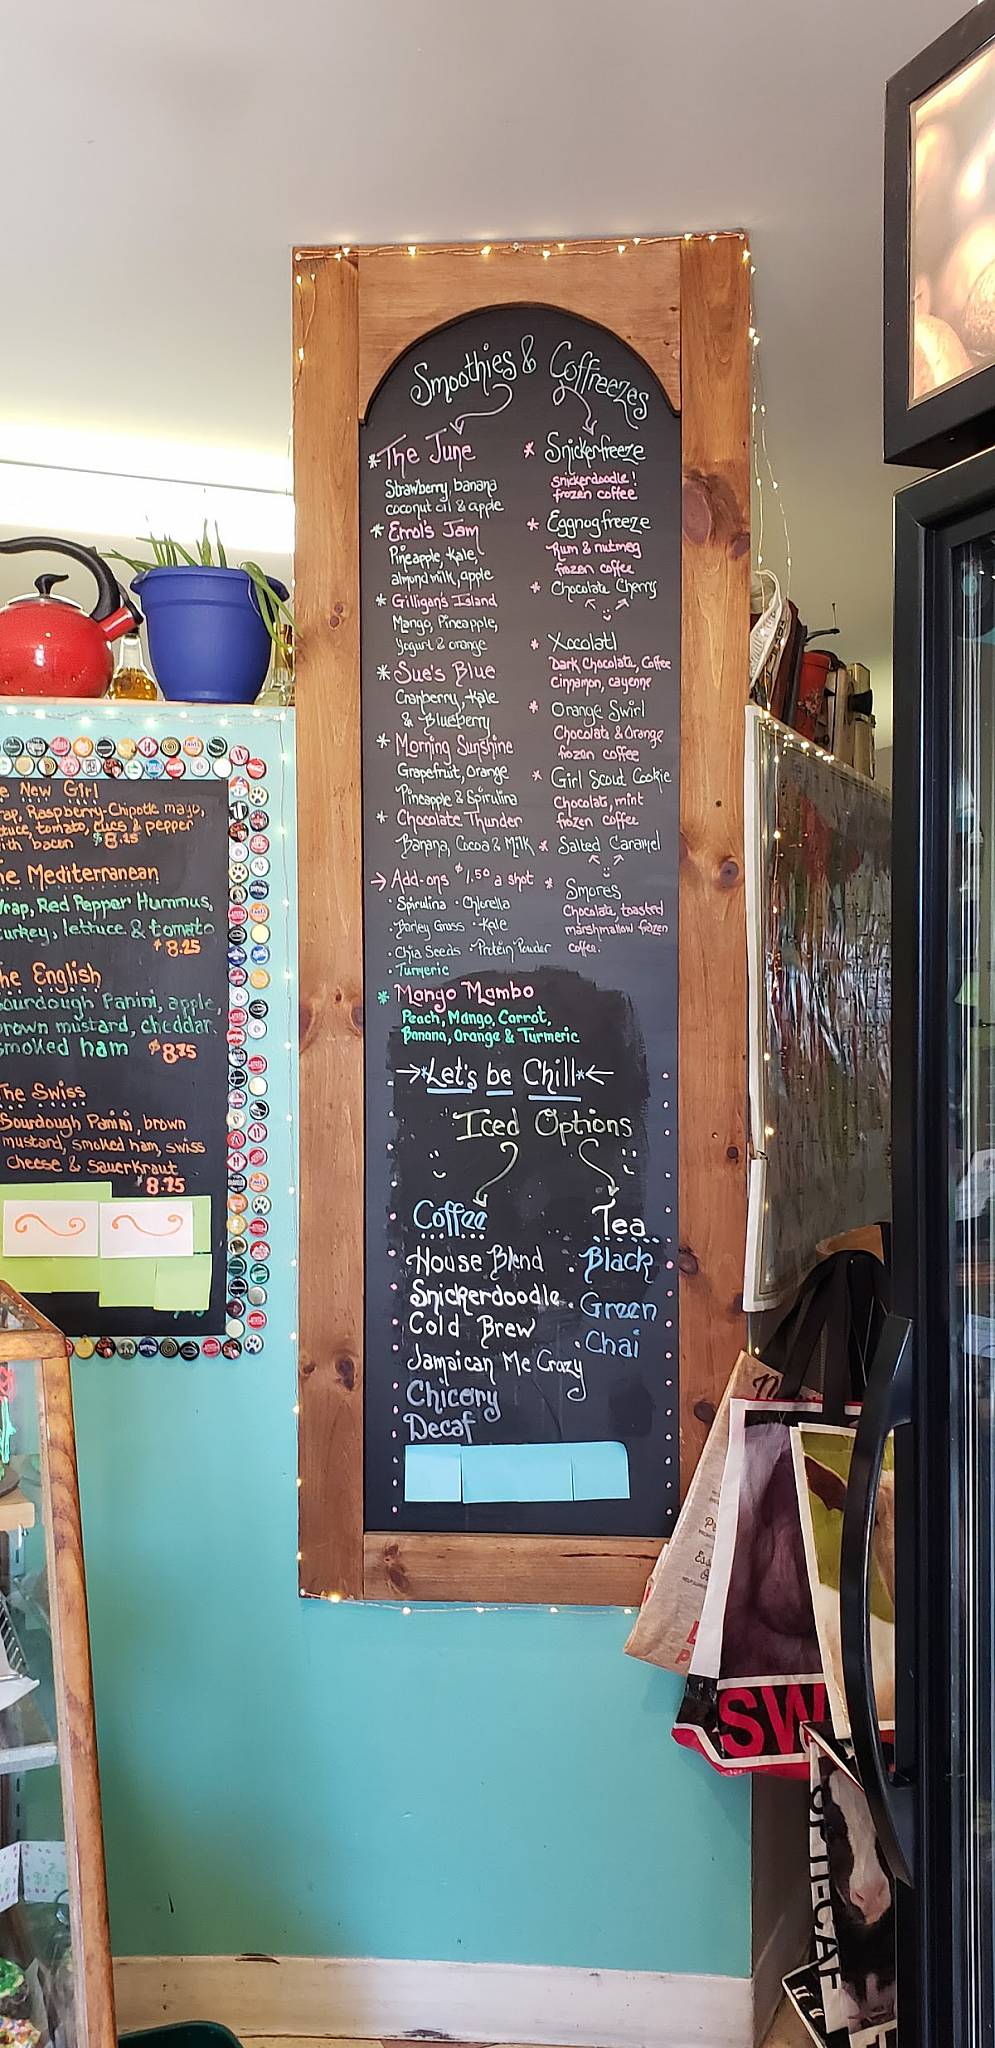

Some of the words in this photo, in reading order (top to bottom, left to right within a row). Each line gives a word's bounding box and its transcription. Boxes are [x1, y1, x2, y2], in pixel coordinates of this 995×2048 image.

[410, 344, 517, 406] Smoothies
[522, 334, 536, 373] &
[550, 341, 648, 429] Coffreezes
[379, 434, 420, 478] The
[425, 429, 475, 472] June
[545, 432, 646, 475] Snickerfreeze
[454, 478, 497, 500] banana
[553, 488, 592, 502] frozen
[597, 488, 637, 500] coffee
[385, 501, 432, 519] coconut
[435, 500, 451, 513] oil
[456, 500, 466, 512] &
[469, 501, 504, 519] apple
[442, 519, 484, 555] Jam
[389, 545, 444, 572] Pineapple,
[546, 542, 578, 561] Rum
[582, 541, 592, 554] &
[594, 542, 641, 558] nutmeg
[555, 562, 595, 576] frozen
[600, 561, 634, 577] coffee
[551, 581, 610, 603] Chocolate
[616, 578, 658, 599] Cherry
[391, 593, 448, 614] Gilligan's
[452, 593, 497, 607] Island
[392, 616, 433, 634] Mango,
[438, 615, 497, 632] Pineapple,
[396, 637, 434, 654] Yogurt
[436, 638, 445, 649] &
[548, 632, 617, 651] Xocolatl
[394, 662, 445, 684] Sue's
[452, 661, 496, 687] Blue
[549, 657, 580, 672] Dark
[582, 657, 639, 673] Chocolate,
[641, 657, 671, 670] Coffee
[396, 689, 465, 714] Cranberry,
[551, 701, 602, 727] Orange
[609, 700, 645, 722] Swirl
[401, 714, 413, 727] &
[418, 714, 491, 740] Blueberry
[614, 725, 623, 739] &
[624, 725, 665, 749] Orange
[395, 734, 452, 765] Morning
[456, 735, 513, 763] Sunshine
[558, 749, 595, 761] frozen
[602, 748, 640, 763] coffee
[397, 763, 465, 784] Grapefruit,
[551, 766, 583, 789] Girl
[588, 769, 626, 789] Scout
[632, 767, 672, 793] Cookie
[20, 781, 51, 797] New
[63, 779, 98, 798] Girl
[395, 785, 453, 808] Pineapple
[456, 791, 465, 804] &
[466, 786, 517, 813] Spirulina
[614, 792, 643, 806] mint
[145, 819, 194, 836] pepper
[397, 810, 463, 837] Chocolate
[463, 811, 523, 833] Thunder
[557, 812, 593, 830] frozen
[602, 811, 639, 830] coffee
[32, 837, 74, 851] bacon
[395, 833, 451, 860] Banana,
[456, 839, 490, 853] Cocoa
[491, 838, 500, 851] &
[504, 835, 535, 858] Milk
[558, 835, 600, 856] Salted
[609, 830, 661, 853] Caramel
[27, 863, 159, 891] Mediterranean
[390, 868, 449, 895] Add-ons
[494, 874, 503, 887] a
[508, 871, 534, 891] shot
[566, 878, 622, 901] Smores
[37, 893, 69, 915] Red
[73, 892, 132, 921] Pepper
[136, 891, 213, 913] Hummus,
[397, 896, 446, 918] Spirulina
[462, 896, 510, 918] Chlorella
[620, 901, 664, 917] toasted
[62, 919, 127, 938] lettuce
[130, 919, 145, 941] &
[149, 919, 215, 939] tomato
[565, 922, 634, 942] marshmallow
[638, 921, 668, 935] frozen
[395, 946, 422, 963] Chia
[425, 945, 461, 957] Seeds
[472, 940, 515, 963] Protein
[515, 938, 552, 955] Powder
[32, 960, 102, 994] English
[395, 963, 449, 979] Turmeric
[394, 984, 457, 1013] Mango
[461, 981, 535, 1006] Mambo
[55, 1014, 137, 1038] mustard,
[402, 1009, 446, 1027] Peach,
[448, 1011, 495, 1029] Mango,
[498, 1005, 551, 1026] Carrot,
[79, 1037, 129, 1057] ham
[401, 1027, 452, 1045] Banana,
[454, 1029, 501, 1047] Orange
[505, 1030, 515, 1043] &
[517, 1027, 580, 1043] Turmeric
[427, 1056, 478, 1089] Let's
[487, 1061, 511, 1086] be
[523, 1057, 576, 1094] Chill
[31, 1080, 87, 1100] Swiss
[144, 1114, 188, 1131] brown
[453, 1108, 520, 1141] Iced
[535, 1108, 632, 1146] Options
[2, 1135, 67, 1155] mustard,
[72, 1138, 125, 1152] smoked
[166, 1139, 206, 1154] swiss
[68, 1156, 81, 1173] &
[413, 1200, 487, 1237] Coffee
[592, 1197, 646, 1237] Tea
[406, 1246, 482, 1276] House
[486, 1244, 544, 1280] Blend
[579, 1246, 654, 1284] Black
[409, 1279, 560, 1316] Snickerdoodle
[580, 1292, 657, 1322] Green
[409, 1311, 460, 1338] Cold
[477, 1314, 536, 1348] Brew
[585, 1328, 639, 1358] Chai
[407, 1344, 495, 1386] Jamaican
[502, 1350, 531, 1376] Me
[536, 1349, 587, 1401] Crazy
[406, 1380, 501, 1422] Chicory
[403, 1411, 476, 1444] Decaf
